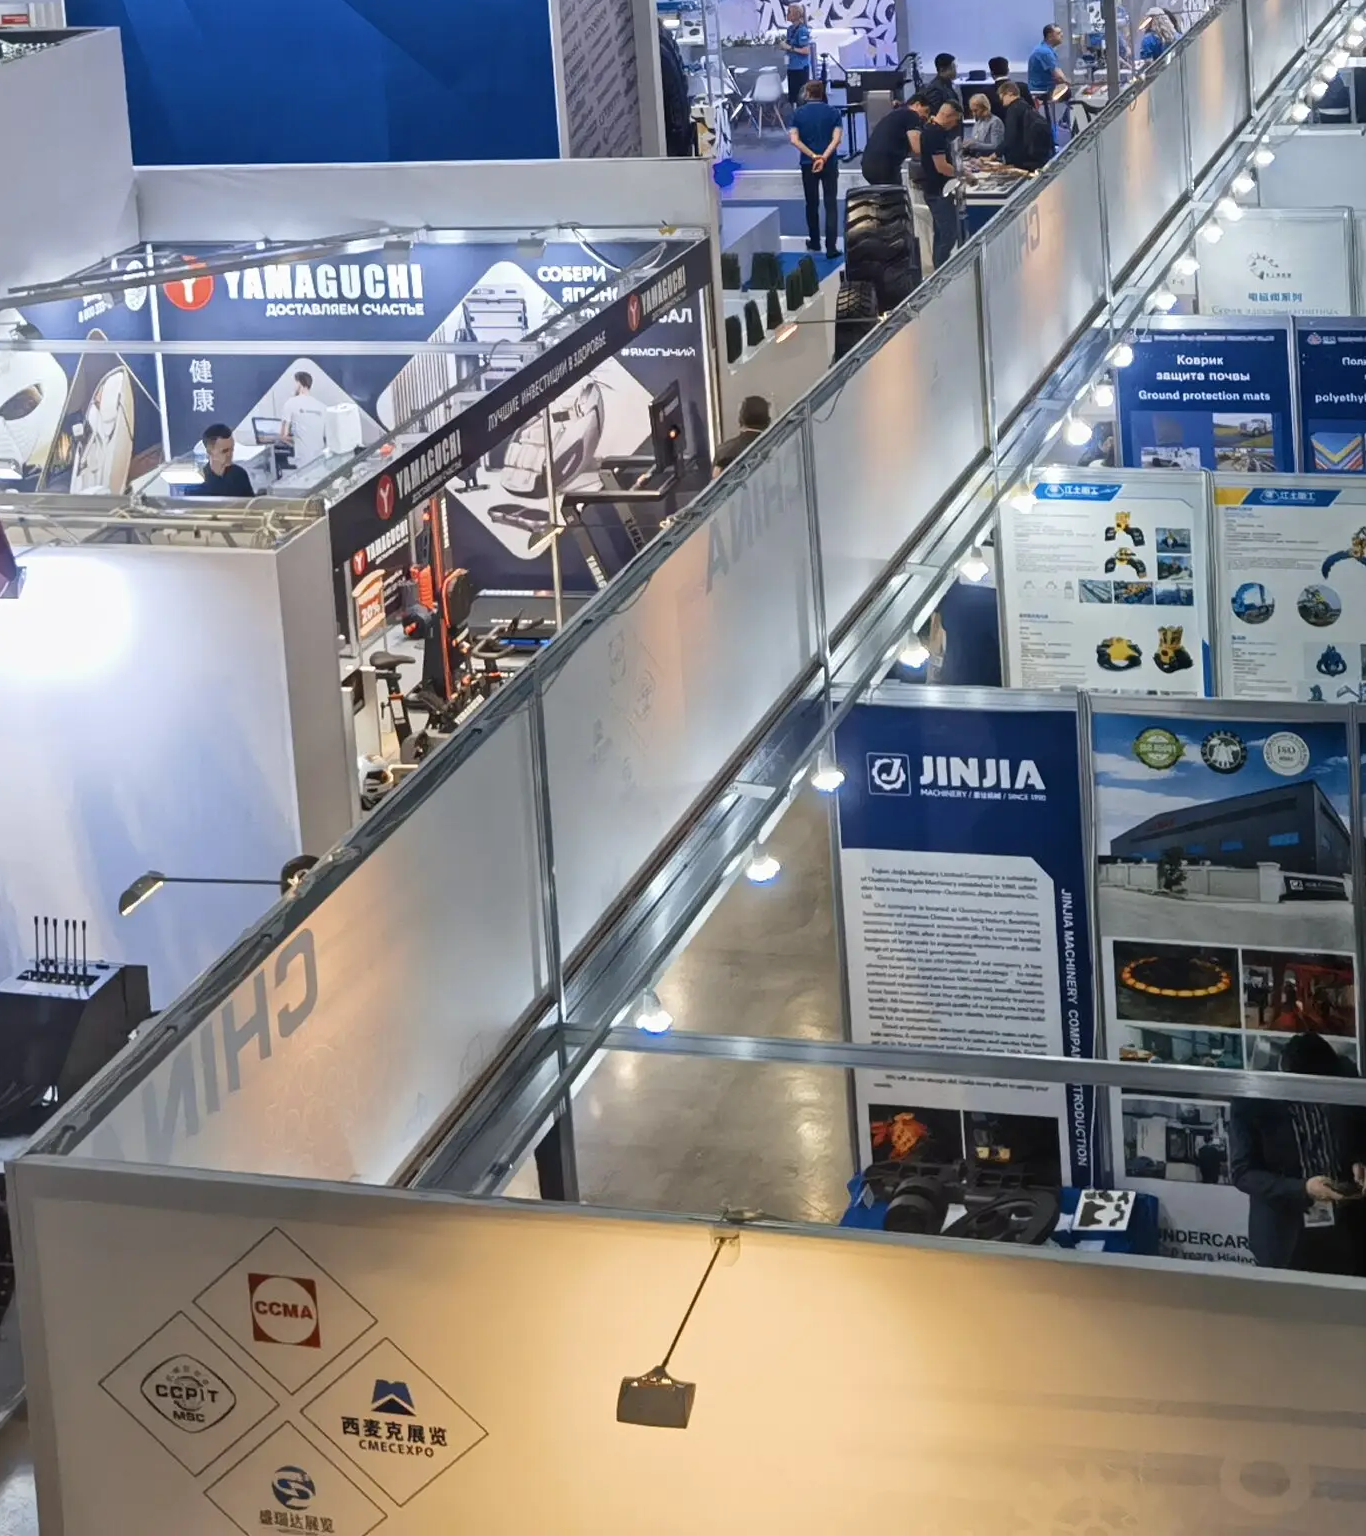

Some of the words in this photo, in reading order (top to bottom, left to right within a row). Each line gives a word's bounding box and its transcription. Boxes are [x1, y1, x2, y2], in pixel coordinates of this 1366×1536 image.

[224, 263, 424, 300] YAMAGUCHI
[537, 266, 607, 283] СОБЕРИ
[641, 265, 687, 316] YAMAGUCHI
[266, 303, 359, 317] ДОСТАВЛЯЕМ
[362, 302, 424, 316] СЧАСТЬЕ
[1176, 354, 1224, 366] Коврик
[1156, 371, 1205, 382] защита
[1209, 371, 1251, 381] почвы
[1138, 390, 1180, 401] Ground
[1183, 390, 1240, 402] protection
[1243, 391, 1271, 402] mats
[488, 395, 520, 432] ЛУЧШИЕ
[396, 429, 462, 500] YAMAGUCHI
[920, 755, 1047, 791] JINJIA
[920, 788, 967, 798] MACHINERY
[1061, 888, 1075, 928] JINJIA
[1063, 930, 1079, 1005] MACHINERY
[1067, 1008, 1082, 1059] COMPAN
[1071, 1083, 1089, 1168] TRODUCTION
[1158, 1227, 1250, 1250] NDERCAR
[254, 1300, 314, 1321] CCMA
[155, 1383, 220, 1404] CCPIT
[173, 1409, 206, 1423] MSC
[341, 1416, 448, 1447] 西麦克展览
[359, 1439, 435, 1458] CMECEXPO
